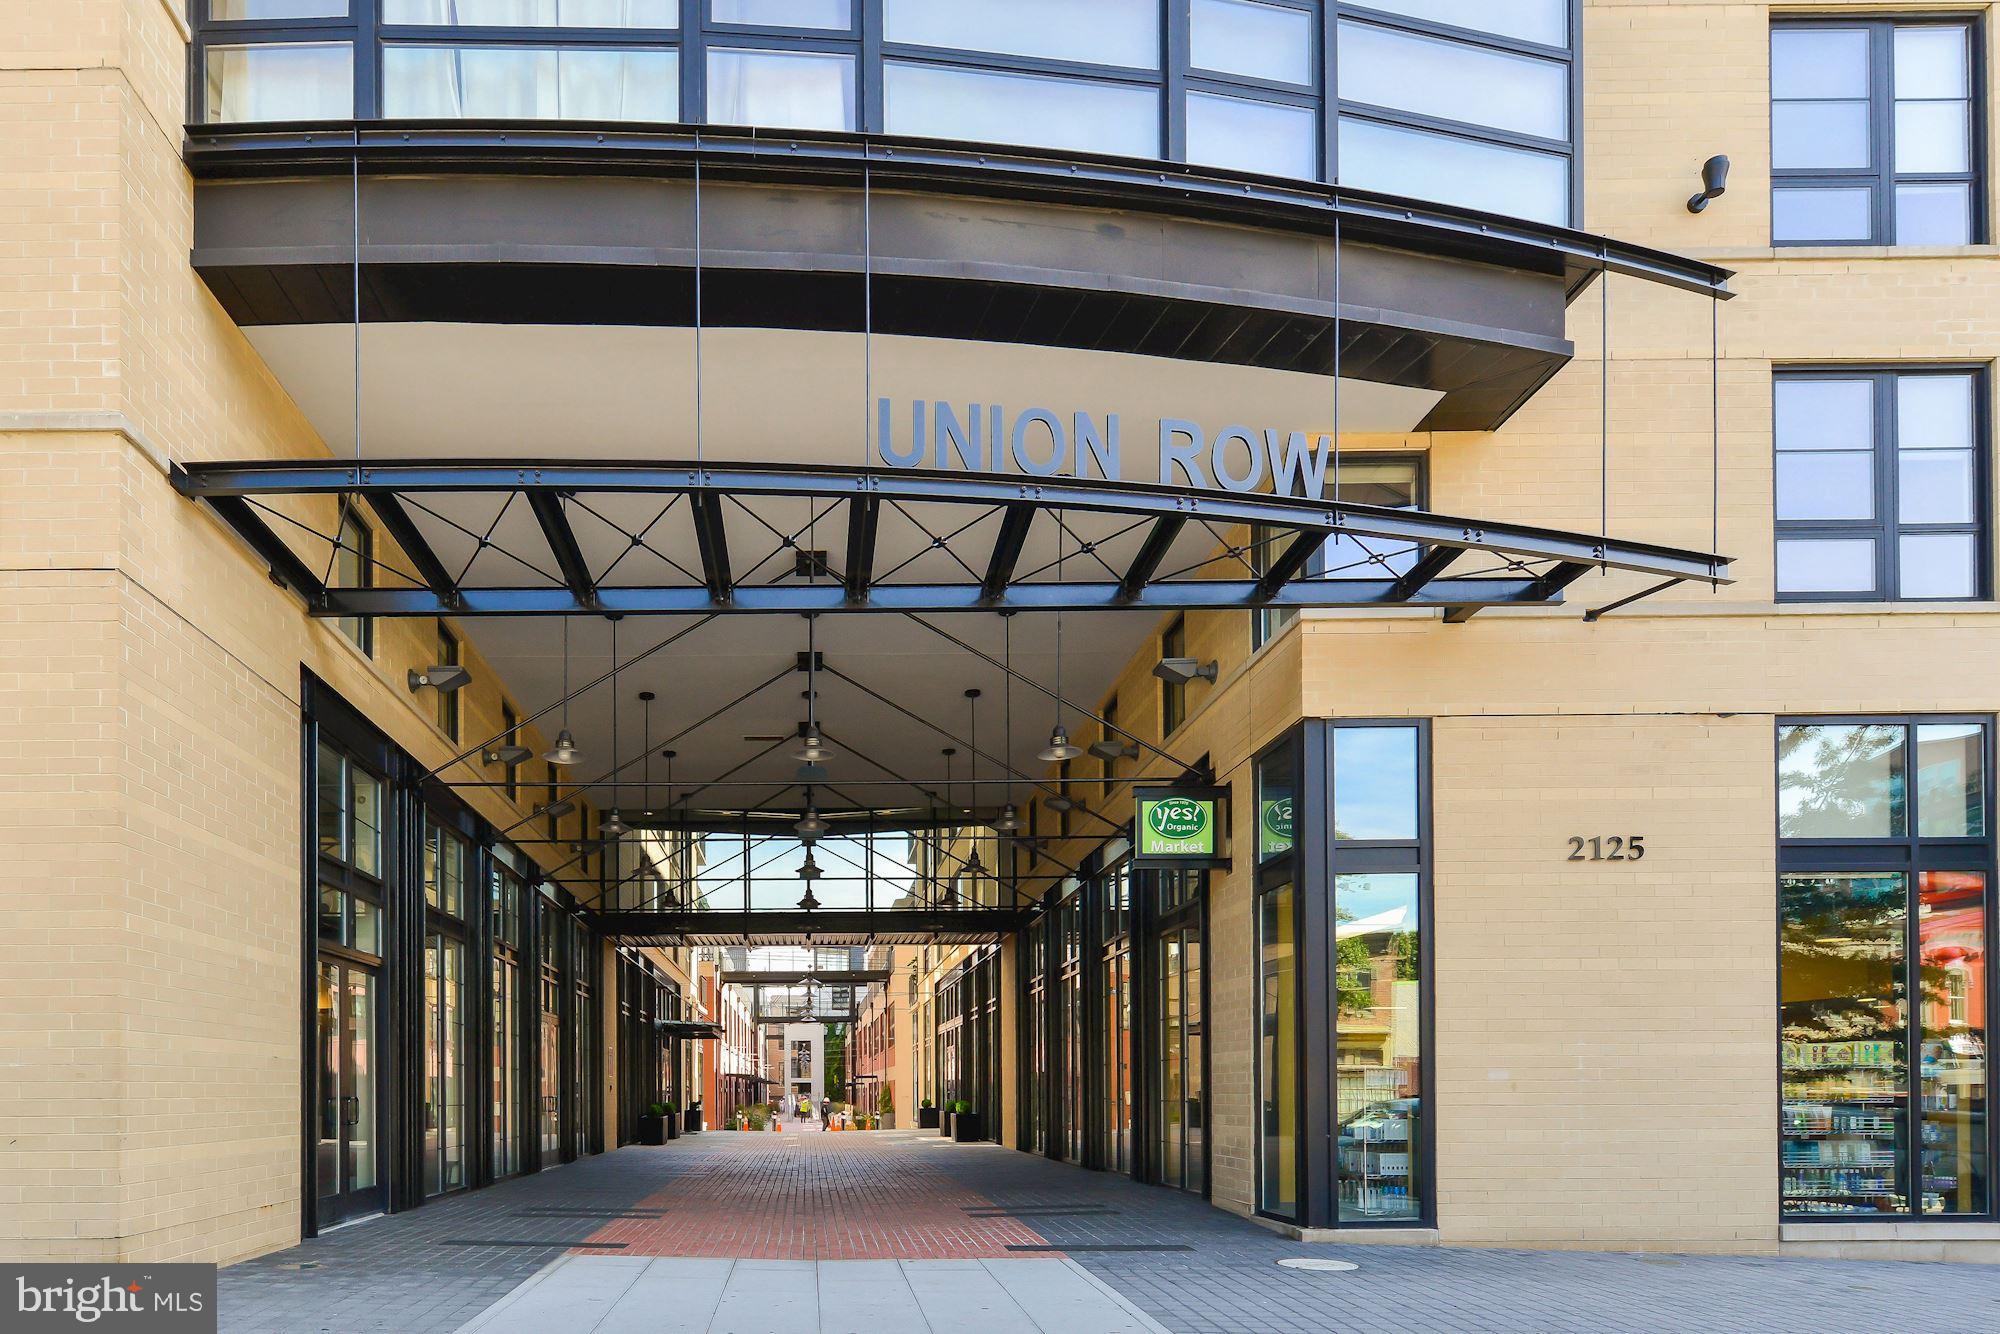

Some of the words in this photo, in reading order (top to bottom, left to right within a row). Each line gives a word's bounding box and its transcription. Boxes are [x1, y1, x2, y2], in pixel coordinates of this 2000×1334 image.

[878, 398, 1120, 479] UNION
[1159, 418, 1330, 499] ROW
[1156, 806, 1200, 831] yes!
[1167, 824, 1199, 832] Organic
[1151, 840, 1204, 853] Market
[1567, 835, 1645, 860] 2125
